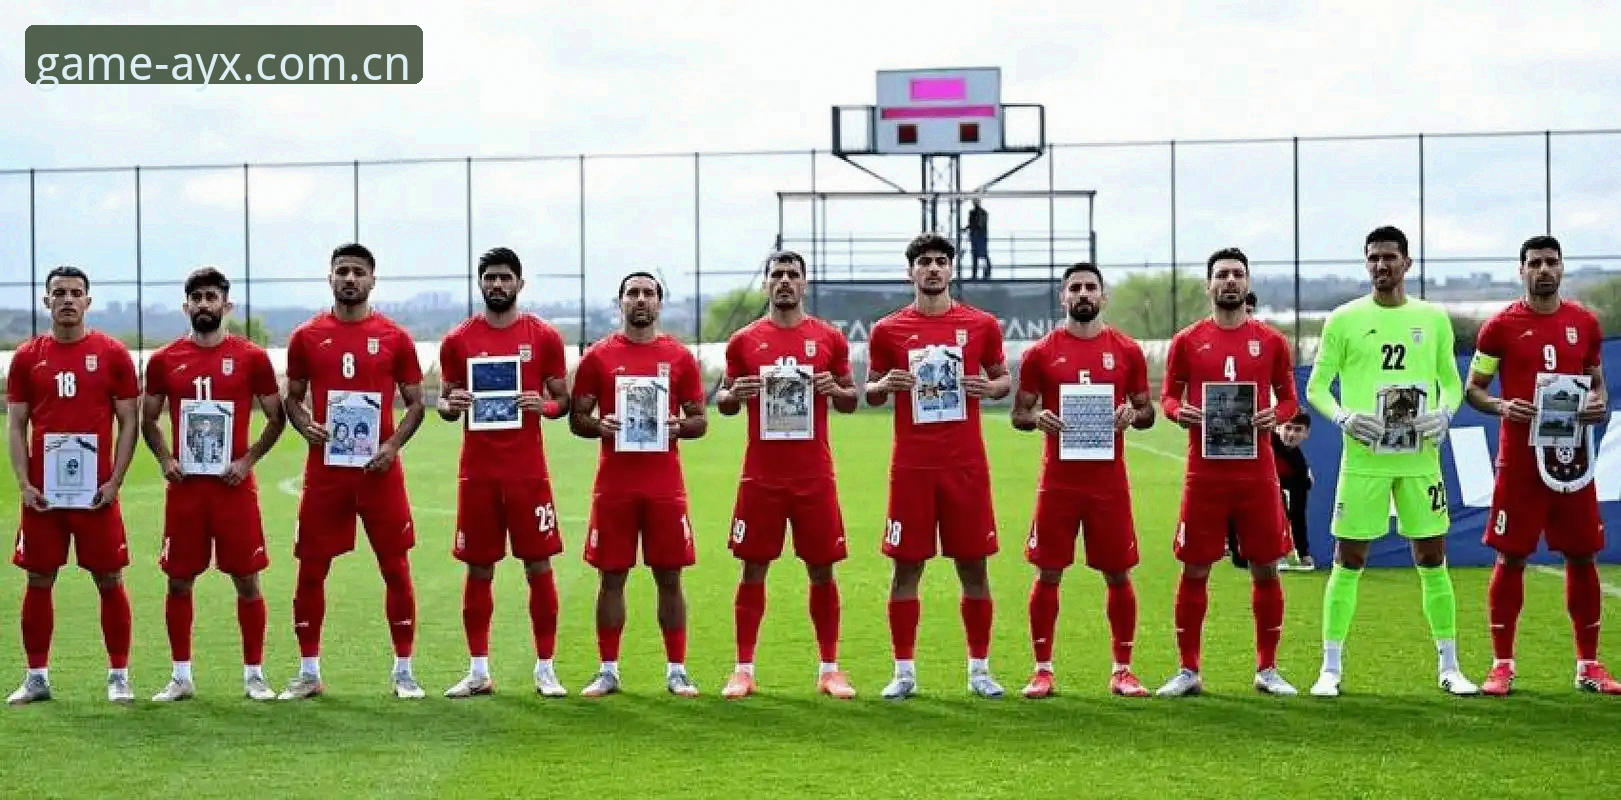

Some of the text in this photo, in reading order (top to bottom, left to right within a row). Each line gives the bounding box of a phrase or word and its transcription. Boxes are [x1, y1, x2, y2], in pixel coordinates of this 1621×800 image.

[342, 352, 355, 378] 8
[1224, 356, 1236, 382] 4
[1380, 344, 1405, 370] 22
[1543, 345, 1557, 370] 9
[54, 371, 76, 398] 18
[192, 376, 212, 400] 11
[1494, 510, 1508, 536] 9
